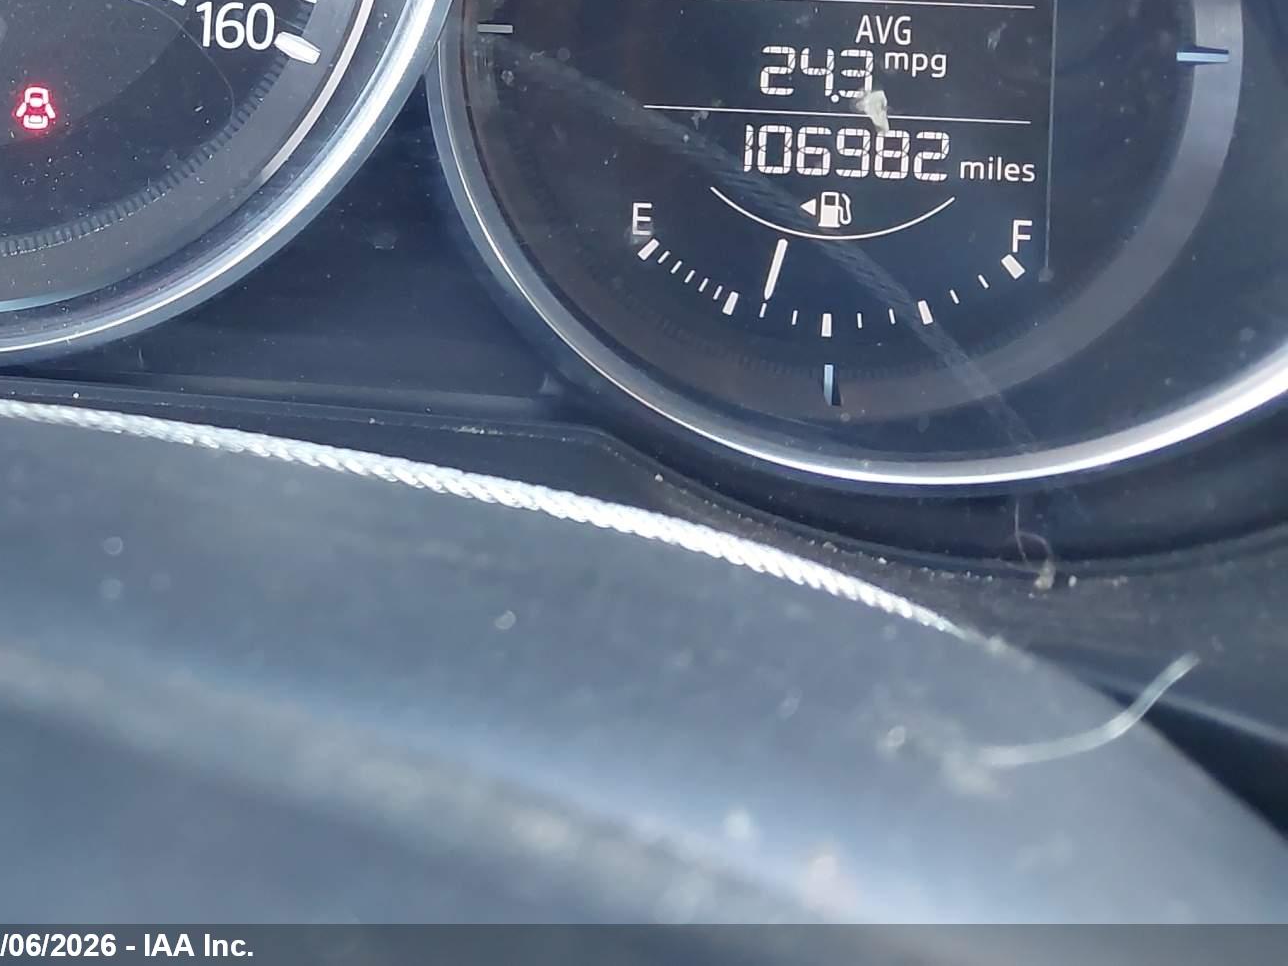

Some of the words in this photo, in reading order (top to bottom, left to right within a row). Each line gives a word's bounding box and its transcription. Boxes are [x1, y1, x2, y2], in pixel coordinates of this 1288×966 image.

[196, 1, 275, 51] 160
[855, 14, 911, 46] AVG
[759, 46, 877, 104] 24.3
[884, 42, 947, 78] mpg
[743, 122, 950, 182] 106982
[959, 156, 1035, 182] miles
[632, 202, 653, 236] E
[1012, 219, 1033, 253] F
